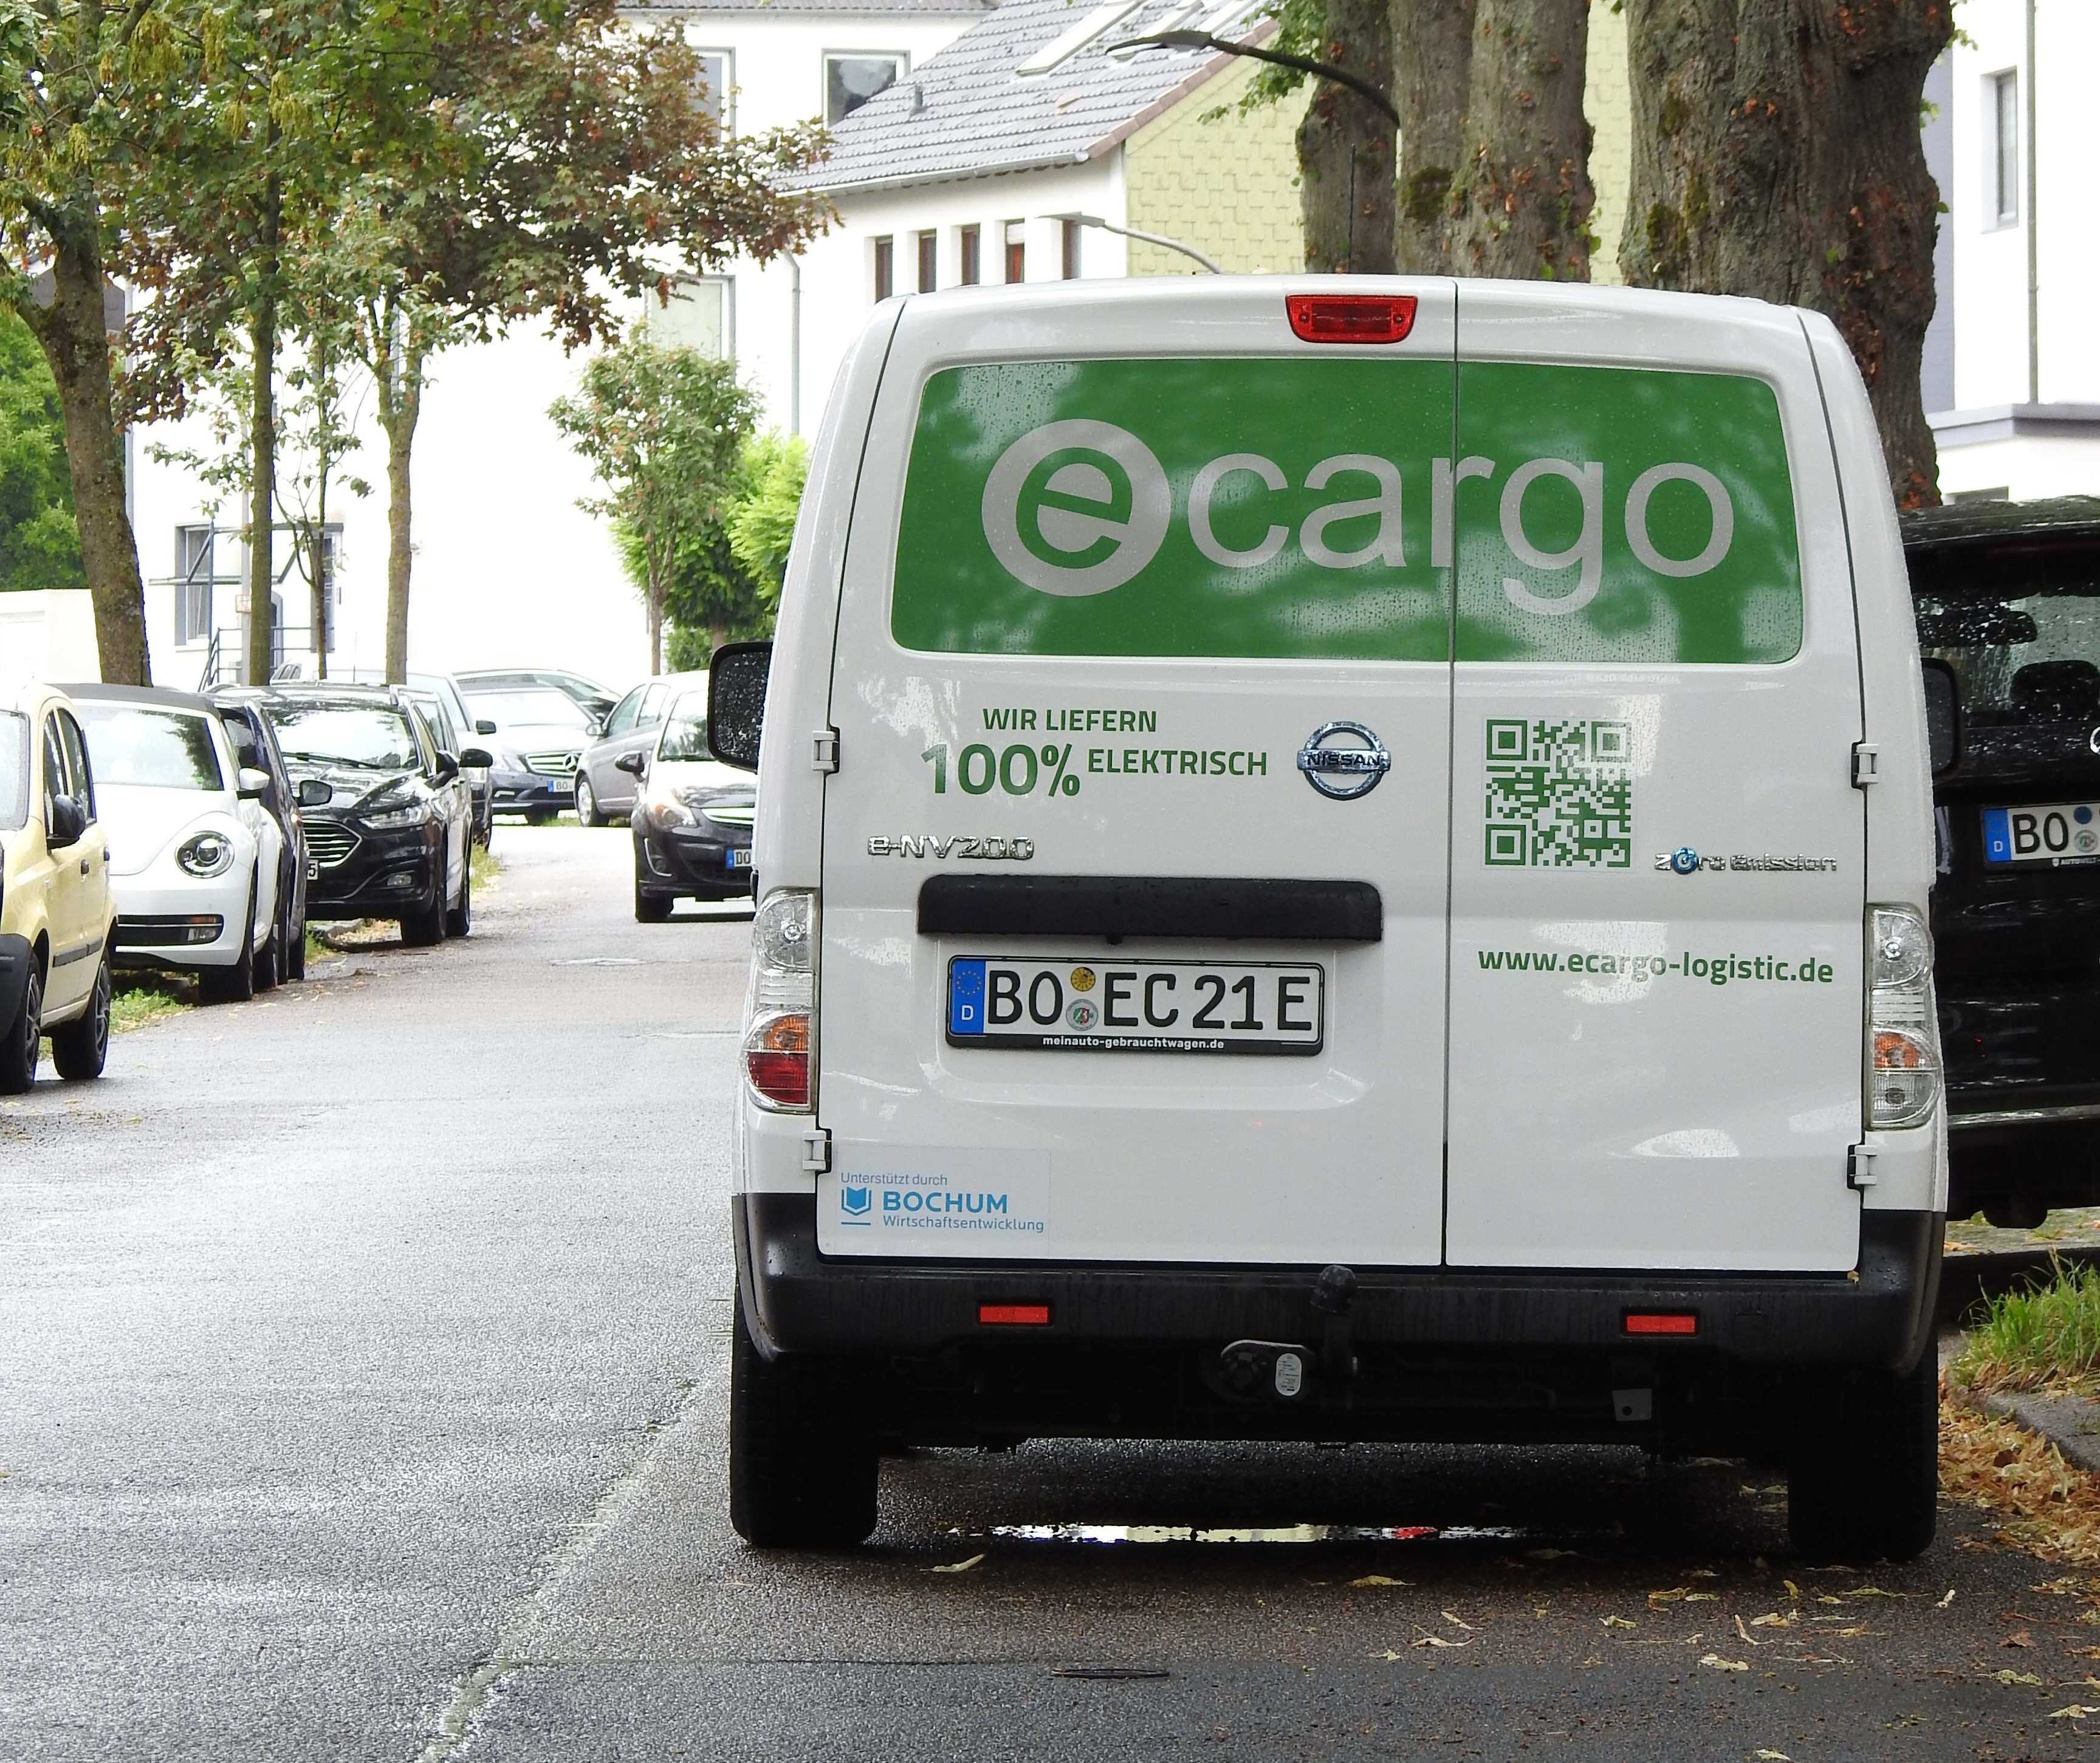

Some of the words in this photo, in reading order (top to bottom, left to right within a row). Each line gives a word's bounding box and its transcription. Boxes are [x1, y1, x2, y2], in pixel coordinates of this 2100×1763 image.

[983, 708, 1035, 731] WIR
[1046, 709, 1157, 733] LIEFERN
[921, 743, 1081, 797] 100%
[1087, 749, 1268, 776] ELEKTRISCH
[1307, 751, 1381, 766] NISSAN
[2012, 812, 2069, 853] BO
[1478, 951, 1834, 985] www.ecargo-logistic.de
[961, 1004, 974, 1021] D
[987, 970, 1063, 1025] BO
[1043, 1035, 1225, 1050] meinauto-gebrauchtwagen.de
[841, 1172, 909, 1185] Unterstützt
[912, 1174, 948, 1186] durch
[883, 1191, 1007, 1214] BOCHUM
[883, 1216, 1045, 1233] Wirtschaftsentwicklung
